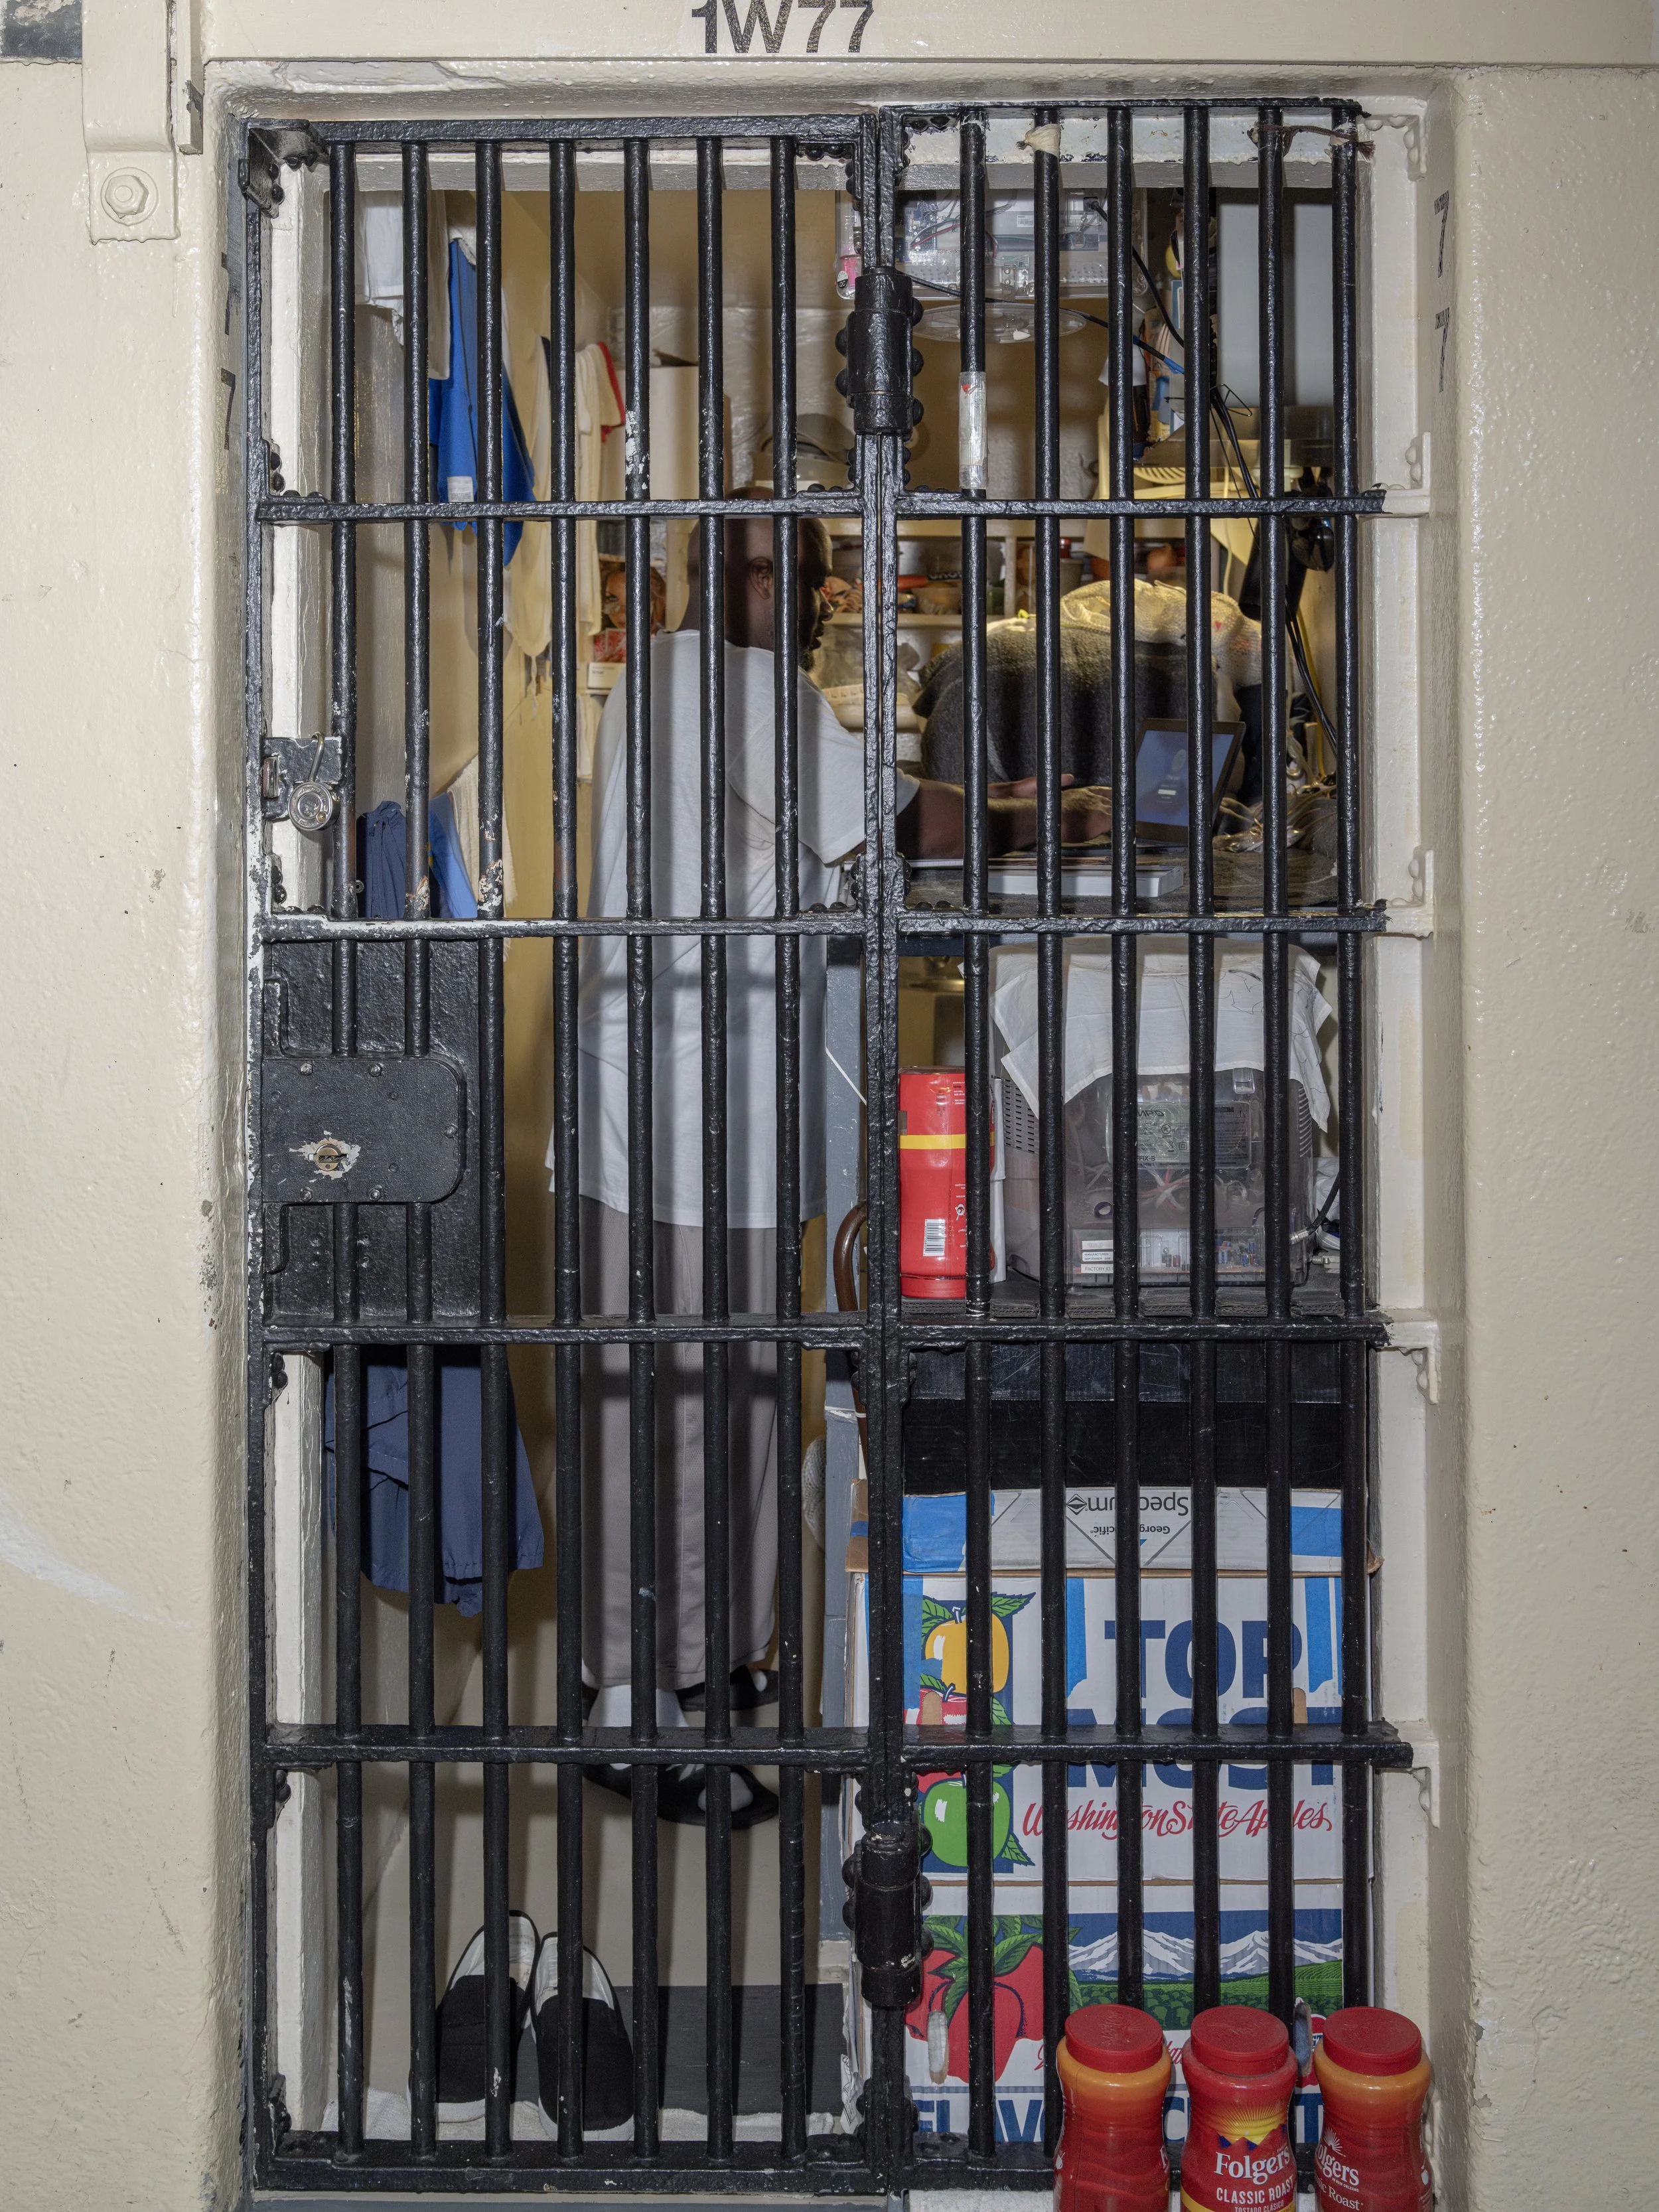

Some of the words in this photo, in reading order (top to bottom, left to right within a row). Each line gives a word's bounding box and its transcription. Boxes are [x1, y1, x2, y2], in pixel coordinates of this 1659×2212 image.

[691, 0, 875, 53] 1W77
[1104, 1619, 1302, 1698] TOP
[1214, 2146, 1290, 2185] Folgers
[1216, 2187, 1265, 2205] CLASSIC
[1269, 2175, 1293, 2201] ROAST
[1328, 2185, 1360, 2211] Roast
